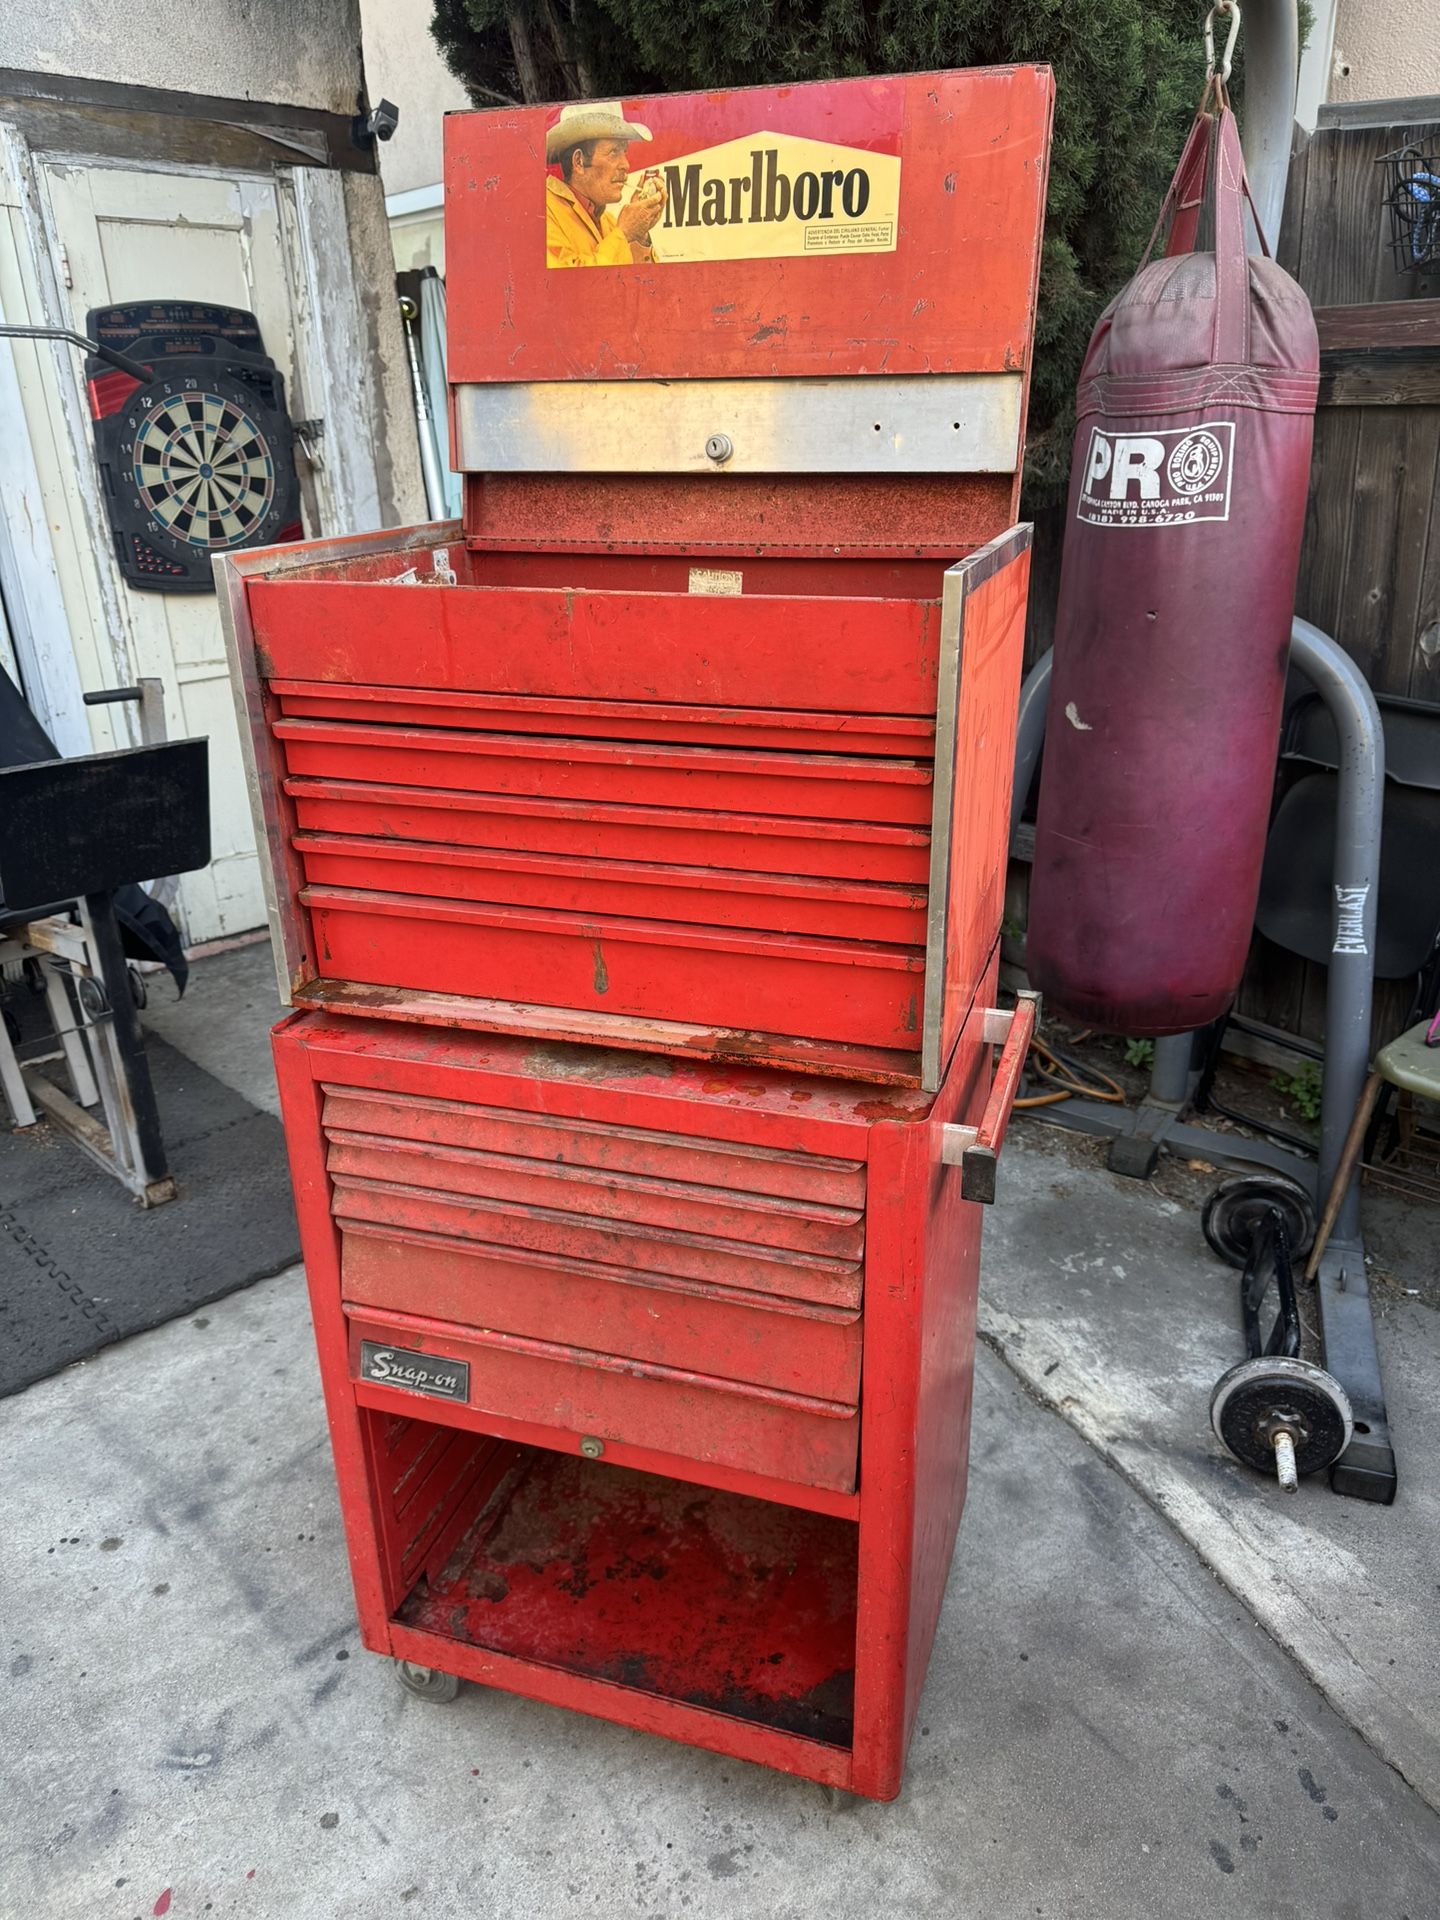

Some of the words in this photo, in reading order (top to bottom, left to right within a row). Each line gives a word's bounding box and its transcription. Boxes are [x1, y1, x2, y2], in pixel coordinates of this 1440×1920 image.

[663, 149, 870, 228] Marlboro
[164, 384, 171, 394] 5
[185, 378, 197, 389] 20
[140, 397, 153, 408] 12
[129, 418, 136, 429] 9
[121, 444, 132, 454] 14
[1172, 440, 1193, 468] BOXING
[1200, 436, 1219, 481] EQUIPMENT
[122, 472, 133, 482] 11
[1141, 500, 1169, 508] CANOGA
[1172, 497, 1191, 506] PARK,
[1193, 494, 1203, 503] CA
[269, 512, 280, 521] 15
[1089, 513, 1113, 523] (818)
[1120, 511, 1195, 523] 998-6720
[171, 539, 177, 548] 7
[1332, 884, 1371, 954] EVERLAST
[370, 1352, 457, 1388] Snap-on
